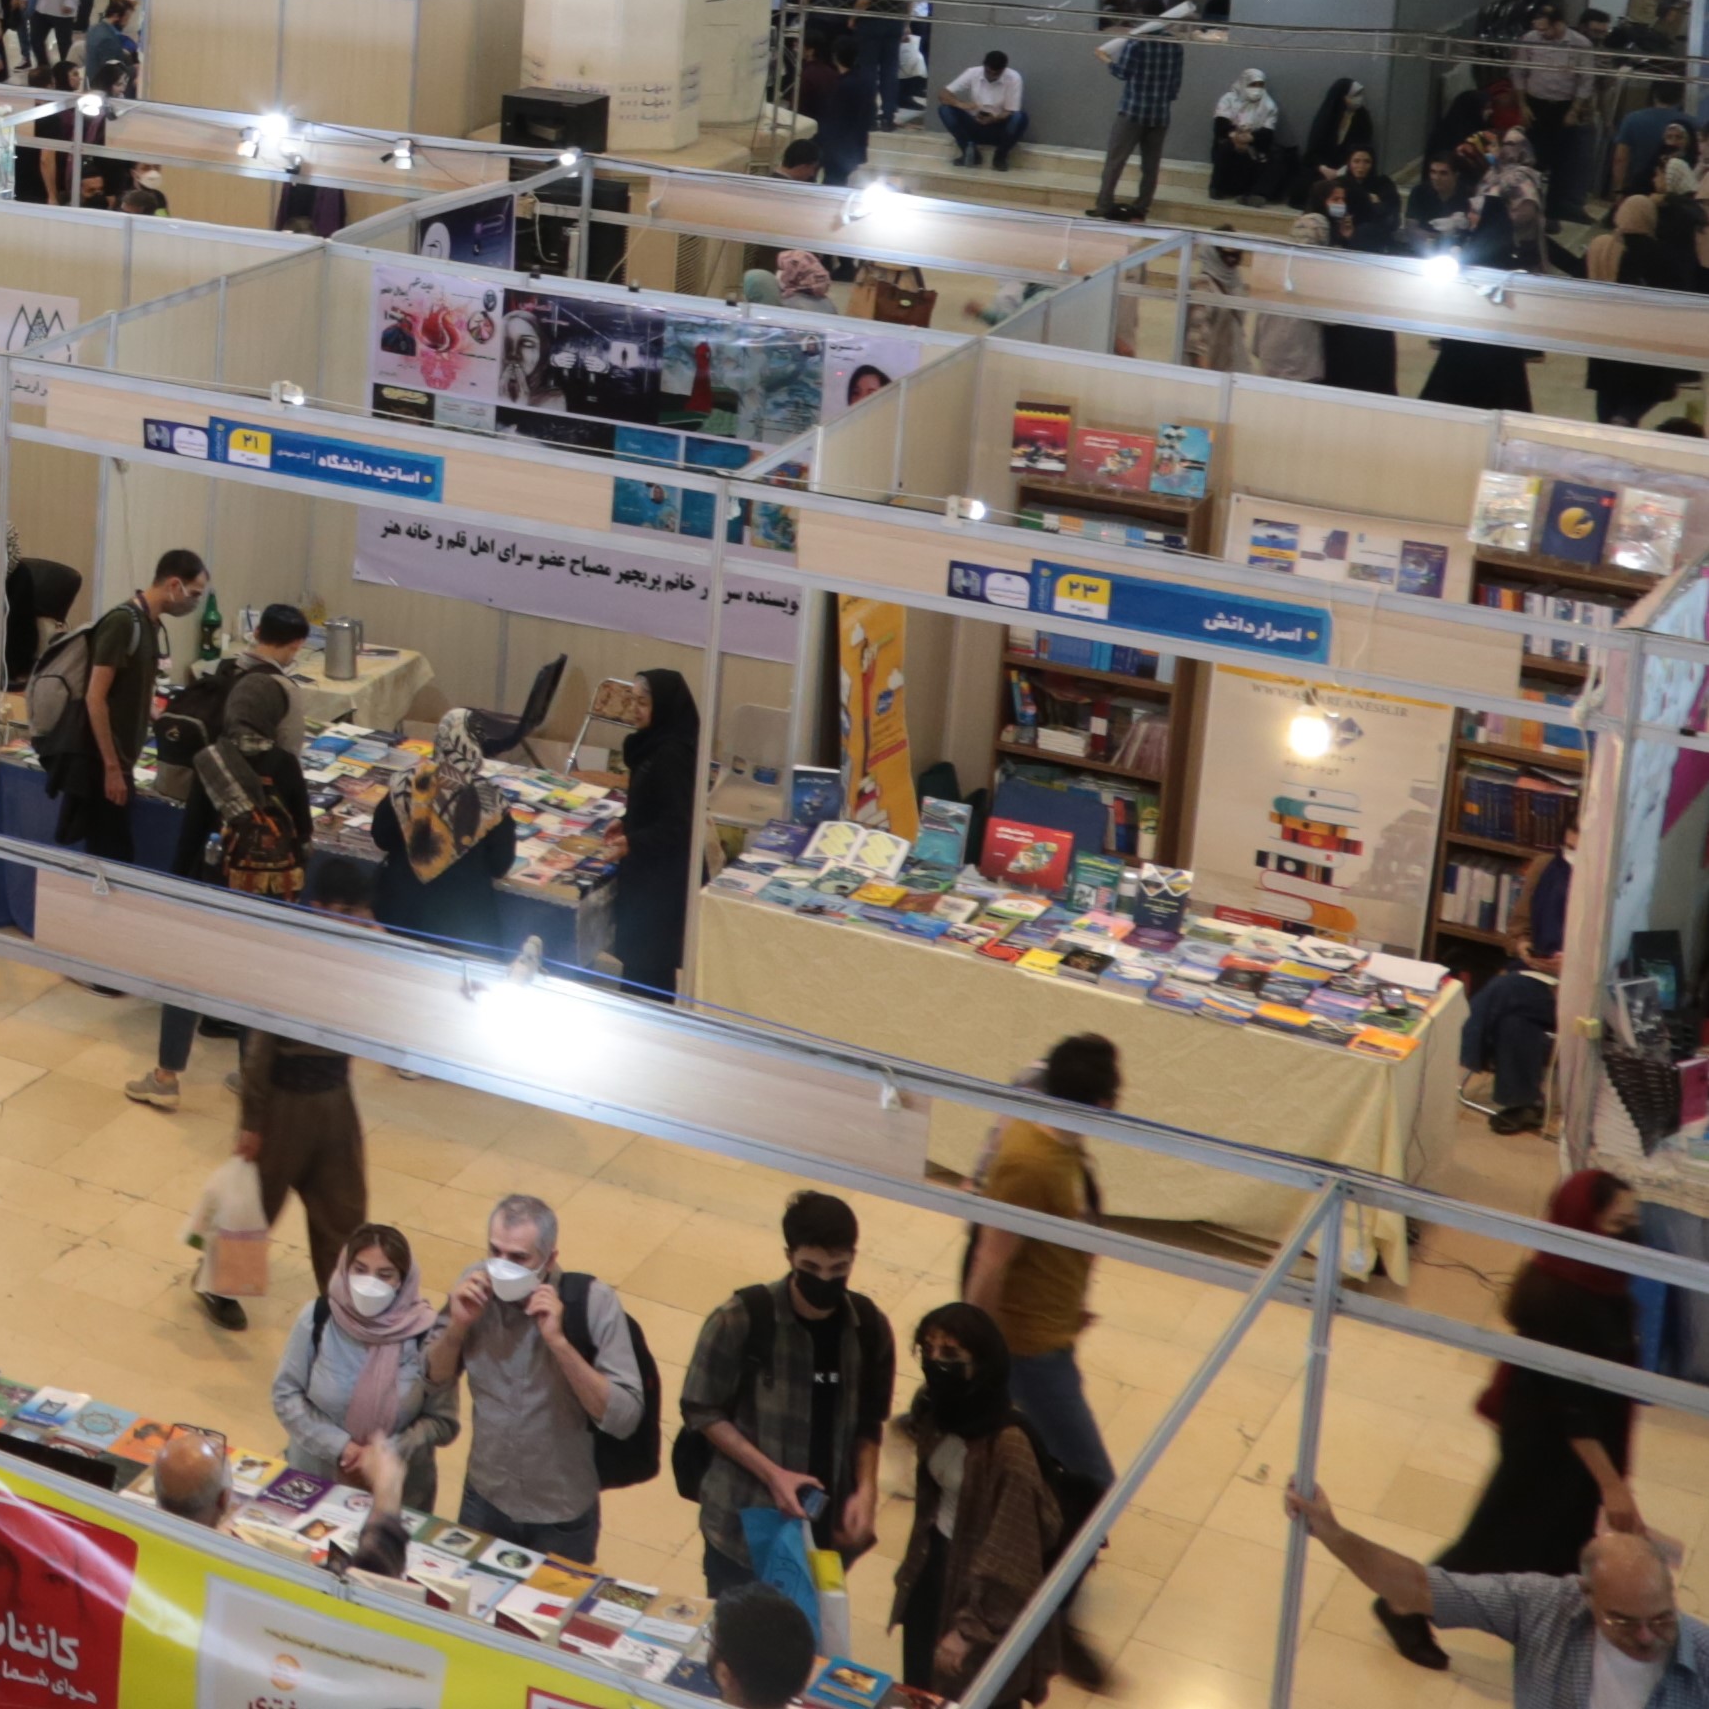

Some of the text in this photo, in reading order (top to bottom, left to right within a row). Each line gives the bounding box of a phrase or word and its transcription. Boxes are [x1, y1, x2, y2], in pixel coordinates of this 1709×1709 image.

[242, 434, 259, 450] ۲۱
[317, 454, 371, 476] دانشگاه
[371, 464, 420, 484] اساتید
[380, 521, 403, 540] هنر
[405, 523, 433, 542] خانه
[445, 530, 468, 552] قلم
[469, 535, 495, 557] اهل
[497, 540, 534, 565] سرای
[536, 549, 567, 572] عضو
[569, 555, 612, 578] مصباح
[664, 574, 697, 593] خانم
[1067, 579, 1101, 600] ۲۳
[746, 591, 801, 615] نویسنده
[1202, 611, 1302, 643] اسرار دانش
[2, 1661, 49, 1687] شما
[51, 1676, 98, 1705] هوای
